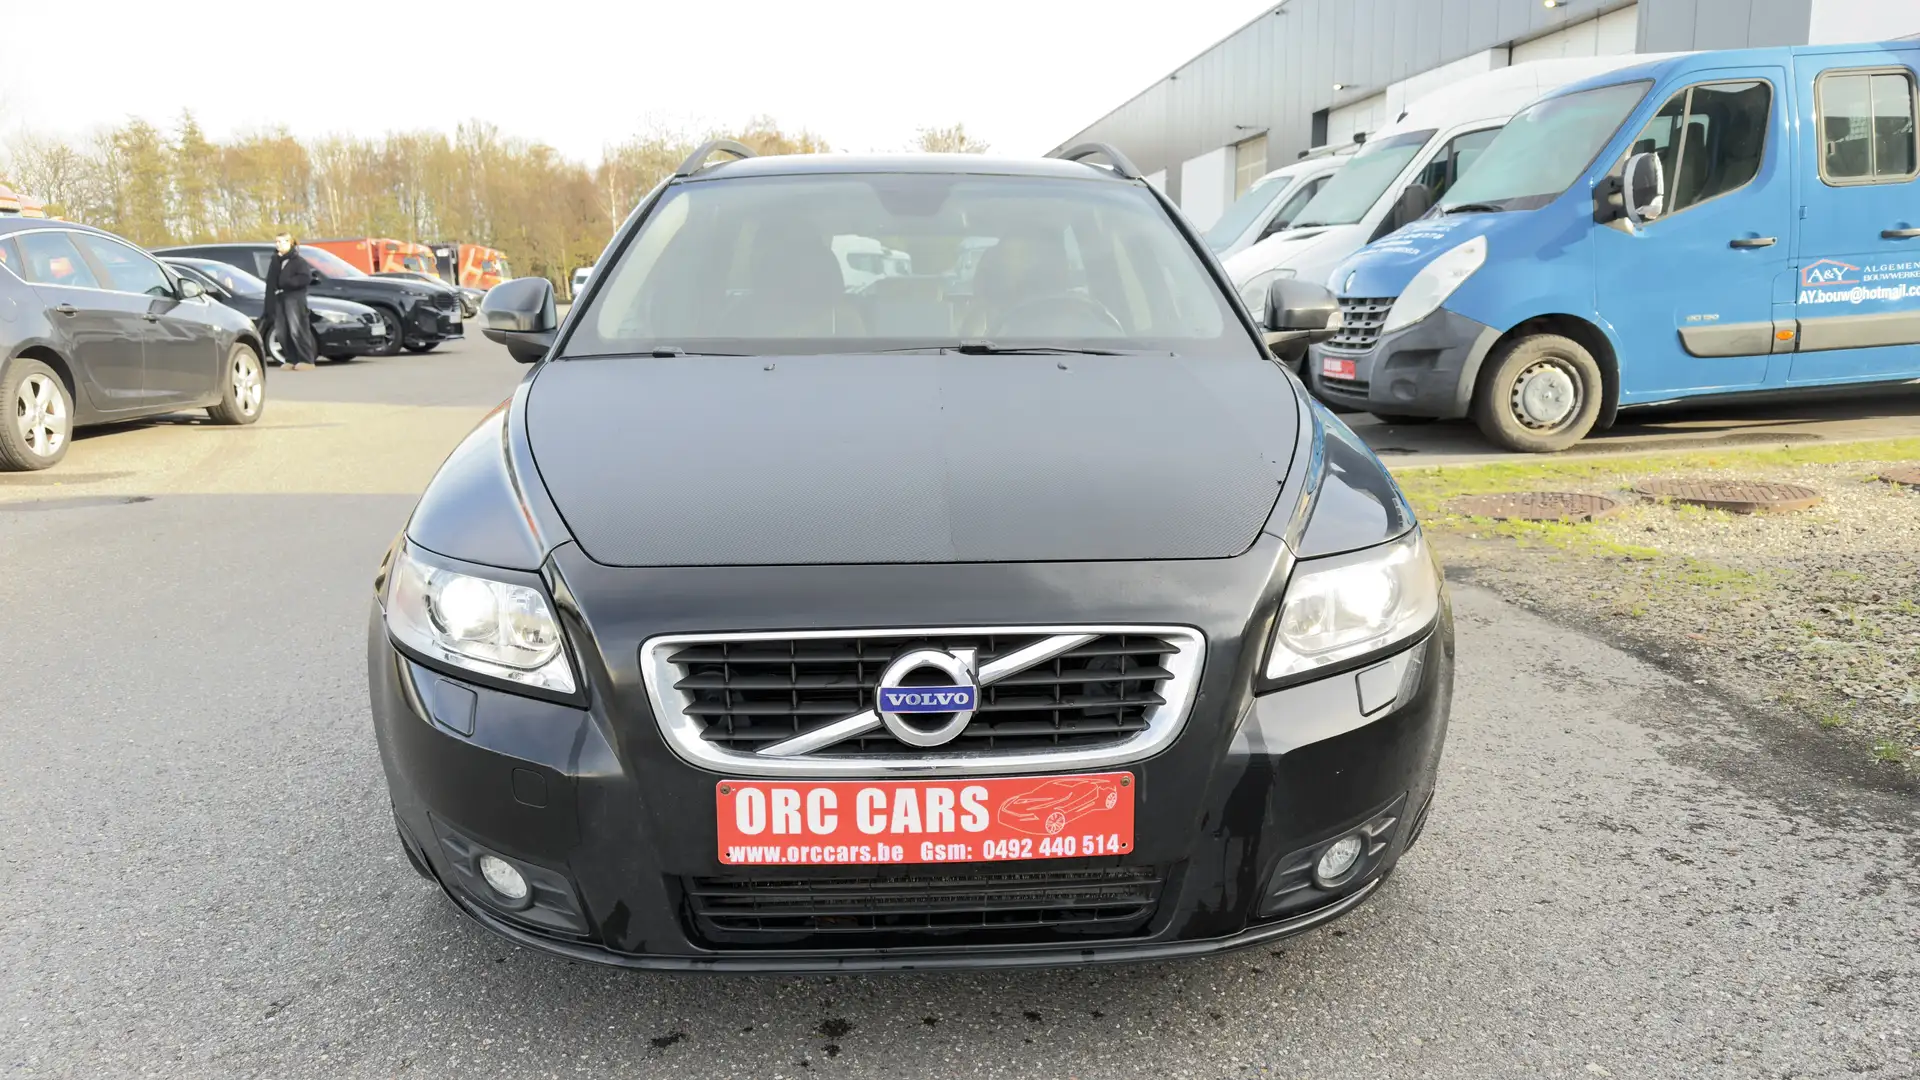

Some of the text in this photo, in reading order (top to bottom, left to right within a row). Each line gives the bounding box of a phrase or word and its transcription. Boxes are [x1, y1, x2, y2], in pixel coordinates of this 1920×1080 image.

[1807, 267, 1849, 283] A&Y
[885, 692, 969, 706] VOLVO
[735, 785, 990, 835] ORC CARS
[728, 834, 1119, 863] www.orccars.be Gsm: 0492 440 514
